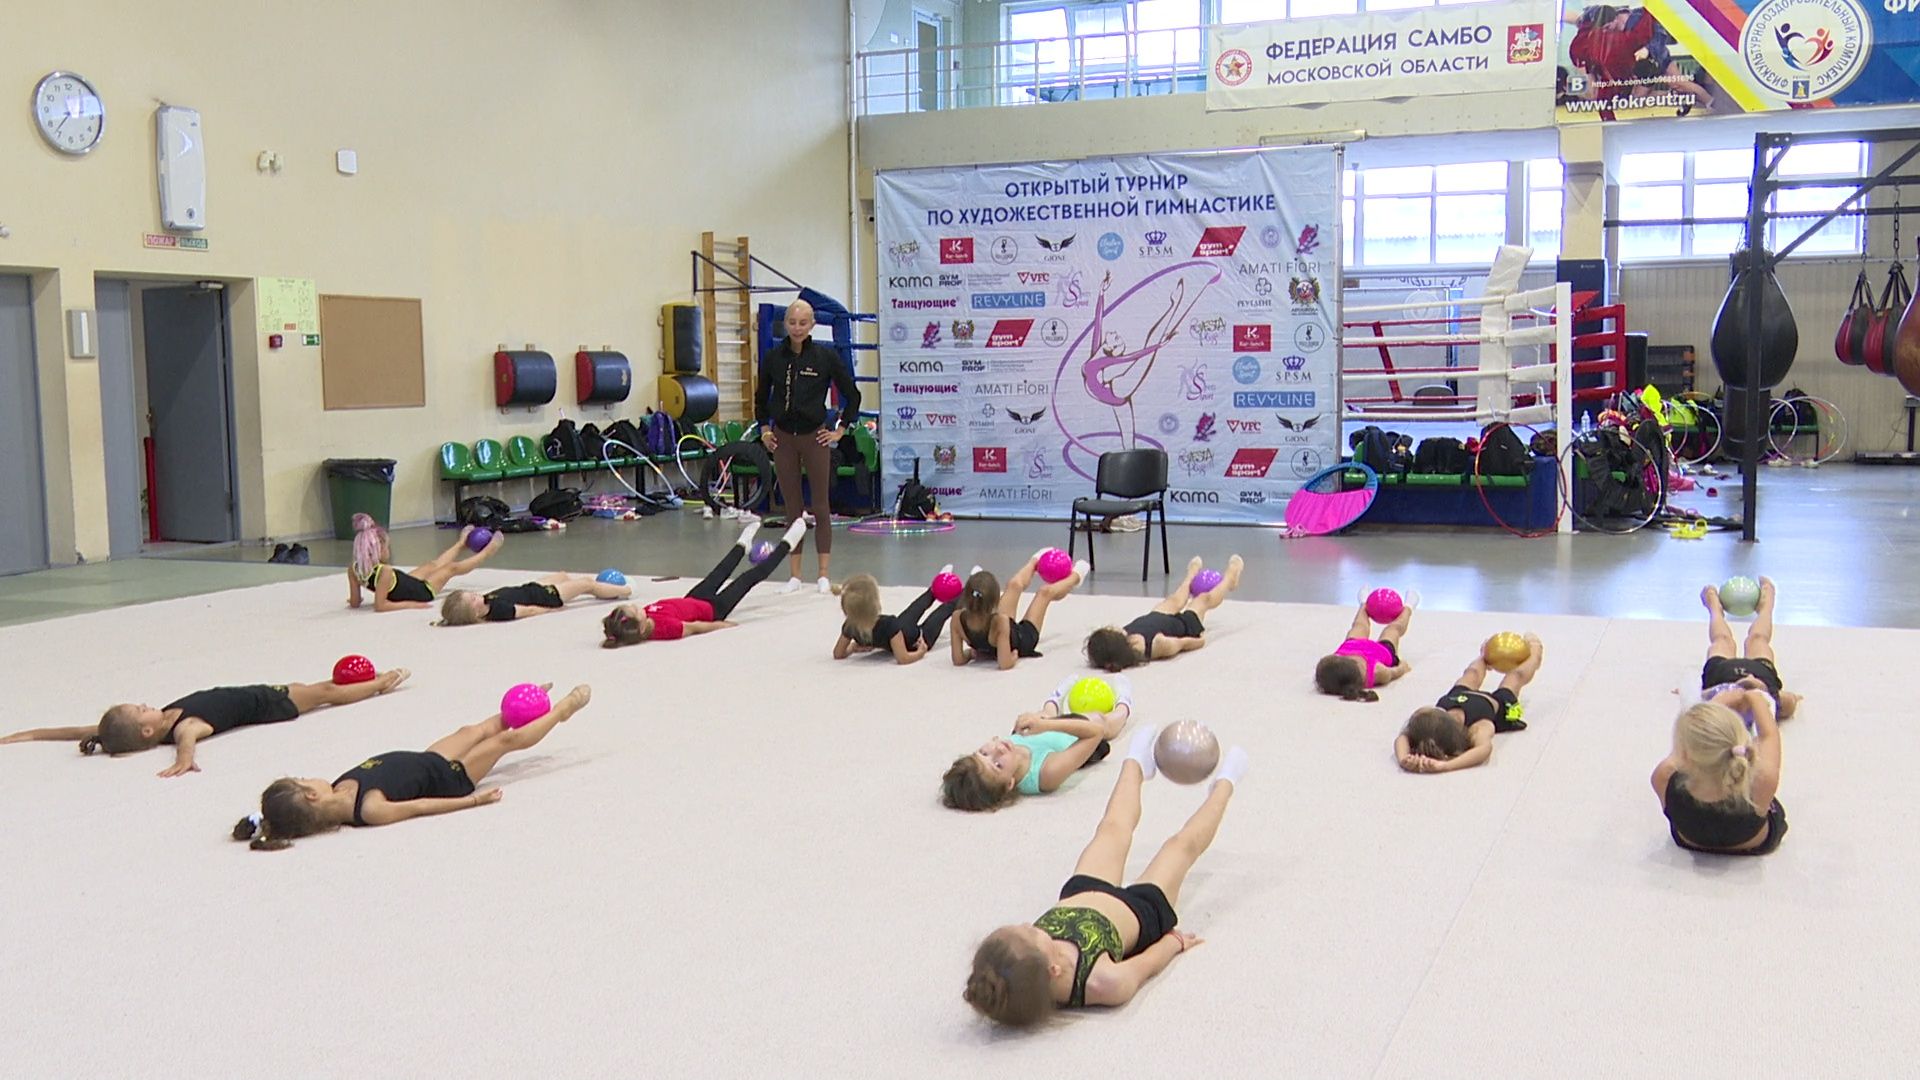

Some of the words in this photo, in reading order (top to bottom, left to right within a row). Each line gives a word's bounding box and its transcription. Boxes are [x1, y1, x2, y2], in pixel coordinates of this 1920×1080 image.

[1265, 32, 1397, 61] ФЕДЕРАЦИЯ
[1408, 25, 1492, 48] САМБО
[1816, 36, 1856, 85] КОМПЛЕКС
[1267, 58, 1392, 86] МОСКОВСКОЙ
[1400, 56, 1489, 74] ОБЛАСТИ
[1565, 92, 1696, 113] www.fokreut.ru
[1005, 172, 1110, 198] ОТКРЫТЫЙ
[1115, 174, 1188, 192] ТУРНИР
[928, 210, 953, 226] ПО
[958, 196, 1139, 226] ХУДОЖЕСТВЕННОЙ
[1145, 194, 1276, 216] ГИМНАСТИКЕ
[1199, 242, 1223, 251] gym
[1199, 248, 1229, 256] sport
[1239, 263, 1281, 275] AMATI
[1031, 272, 1050, 282] VFC
[891, 298, 957, 310] Танцующие
[973, 293, 1044, 307] REVYLINE
[991, 339, 1019, 347] sport
[1276, 371, 1312, 381] SPSM
[893, 383, 958, 396] Танцующие
[975, 383, 1013, 395] AMATI
[1236, 393, 1313, 406] REVYLINE
[1240, 420, 1262, 431] VFC
[1231, 469, 1261, 477] sport
[898, 485, 962, 497] Тющие
[979, 488, 1017, 499] AMATI
[1240, 497, 1266, 505] PROF
